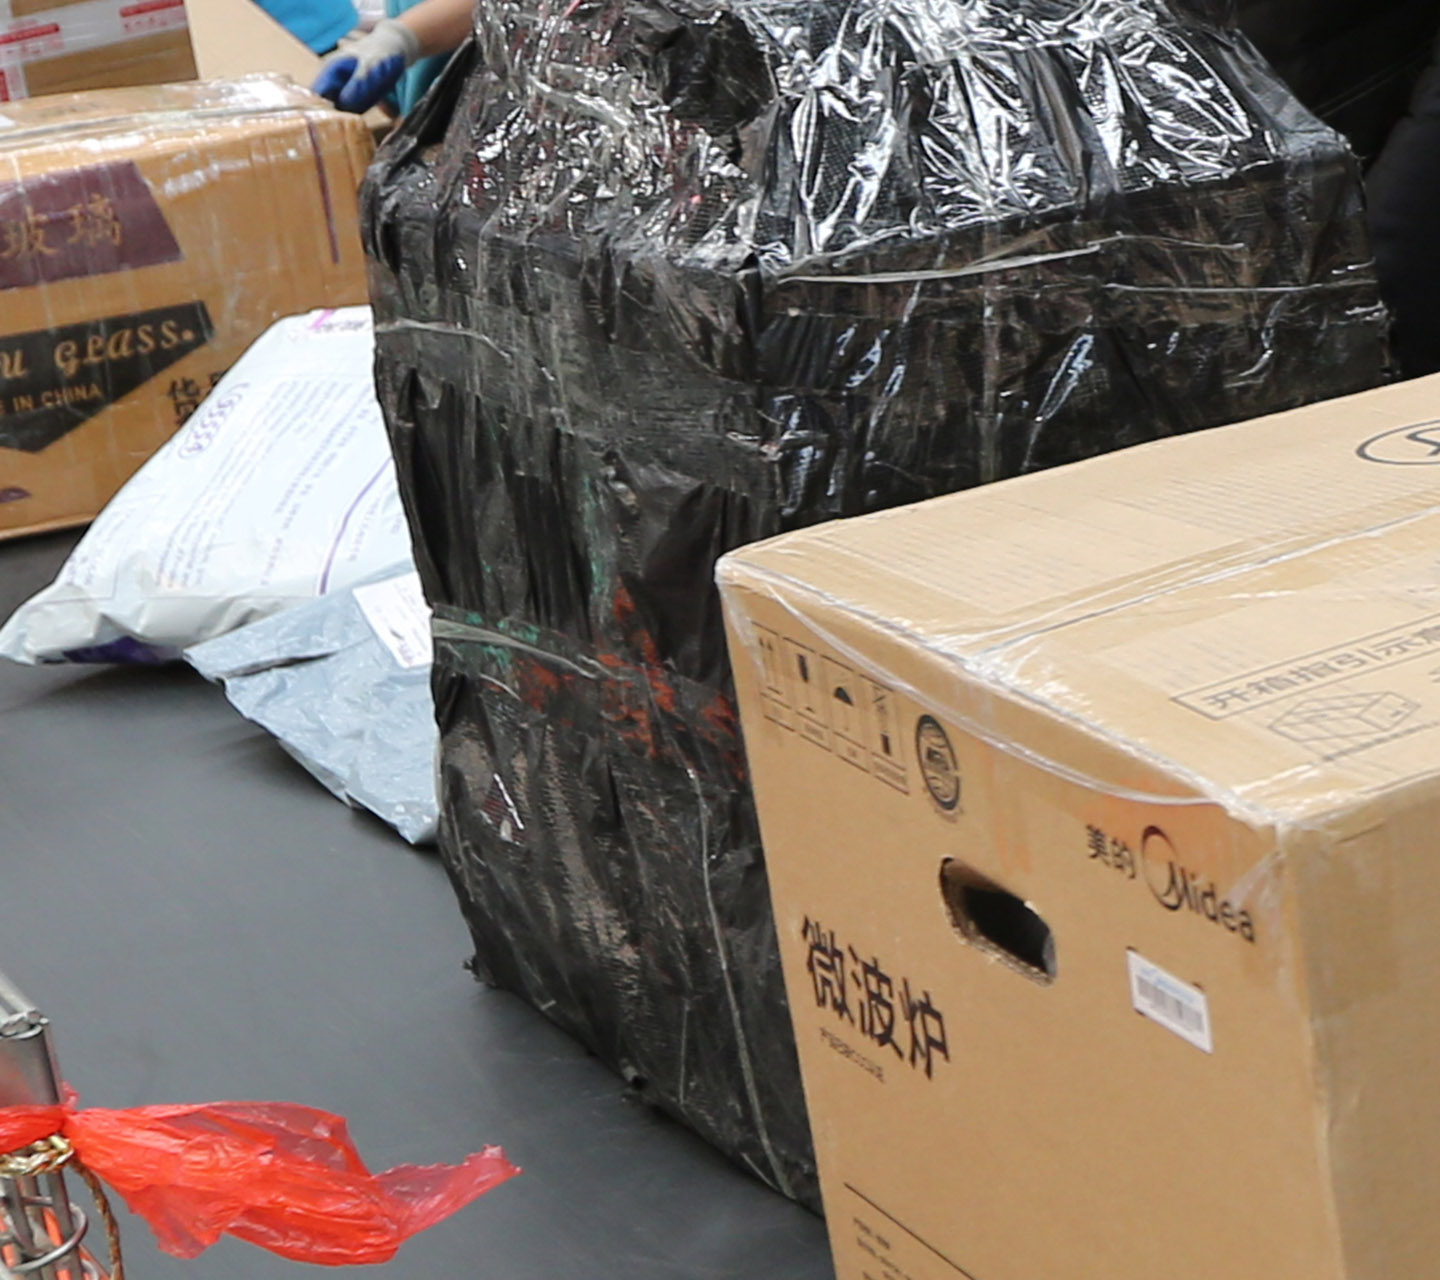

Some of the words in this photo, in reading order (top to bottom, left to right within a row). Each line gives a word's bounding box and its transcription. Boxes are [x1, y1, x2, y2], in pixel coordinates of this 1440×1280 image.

[41, 383, 103, 407] CHINA
[1086, 823, 1138, 880] 美的
[1141, 828, 1257, 945] Midea
[801, 915, 951, 1081] 微波炉
